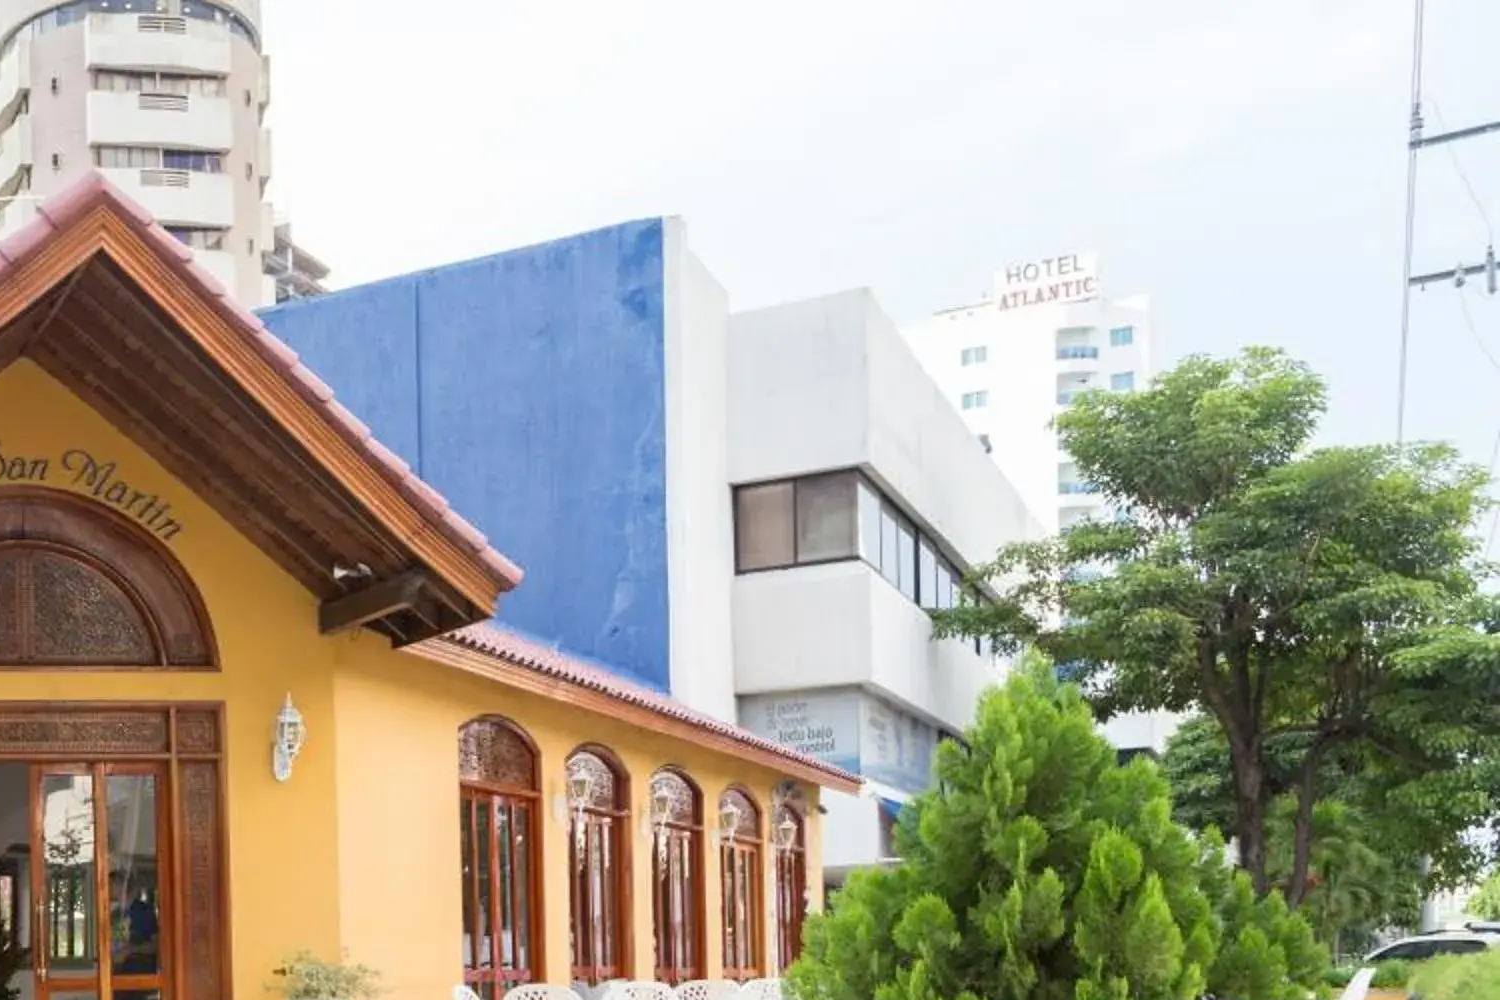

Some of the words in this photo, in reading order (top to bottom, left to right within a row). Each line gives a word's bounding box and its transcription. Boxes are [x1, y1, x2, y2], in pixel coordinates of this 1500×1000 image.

[1006, 254, 1084, 284] HOTEL
[1000, 277, 1096, 311] ATLANTIC
[61, 448, 182, 541] Martin
